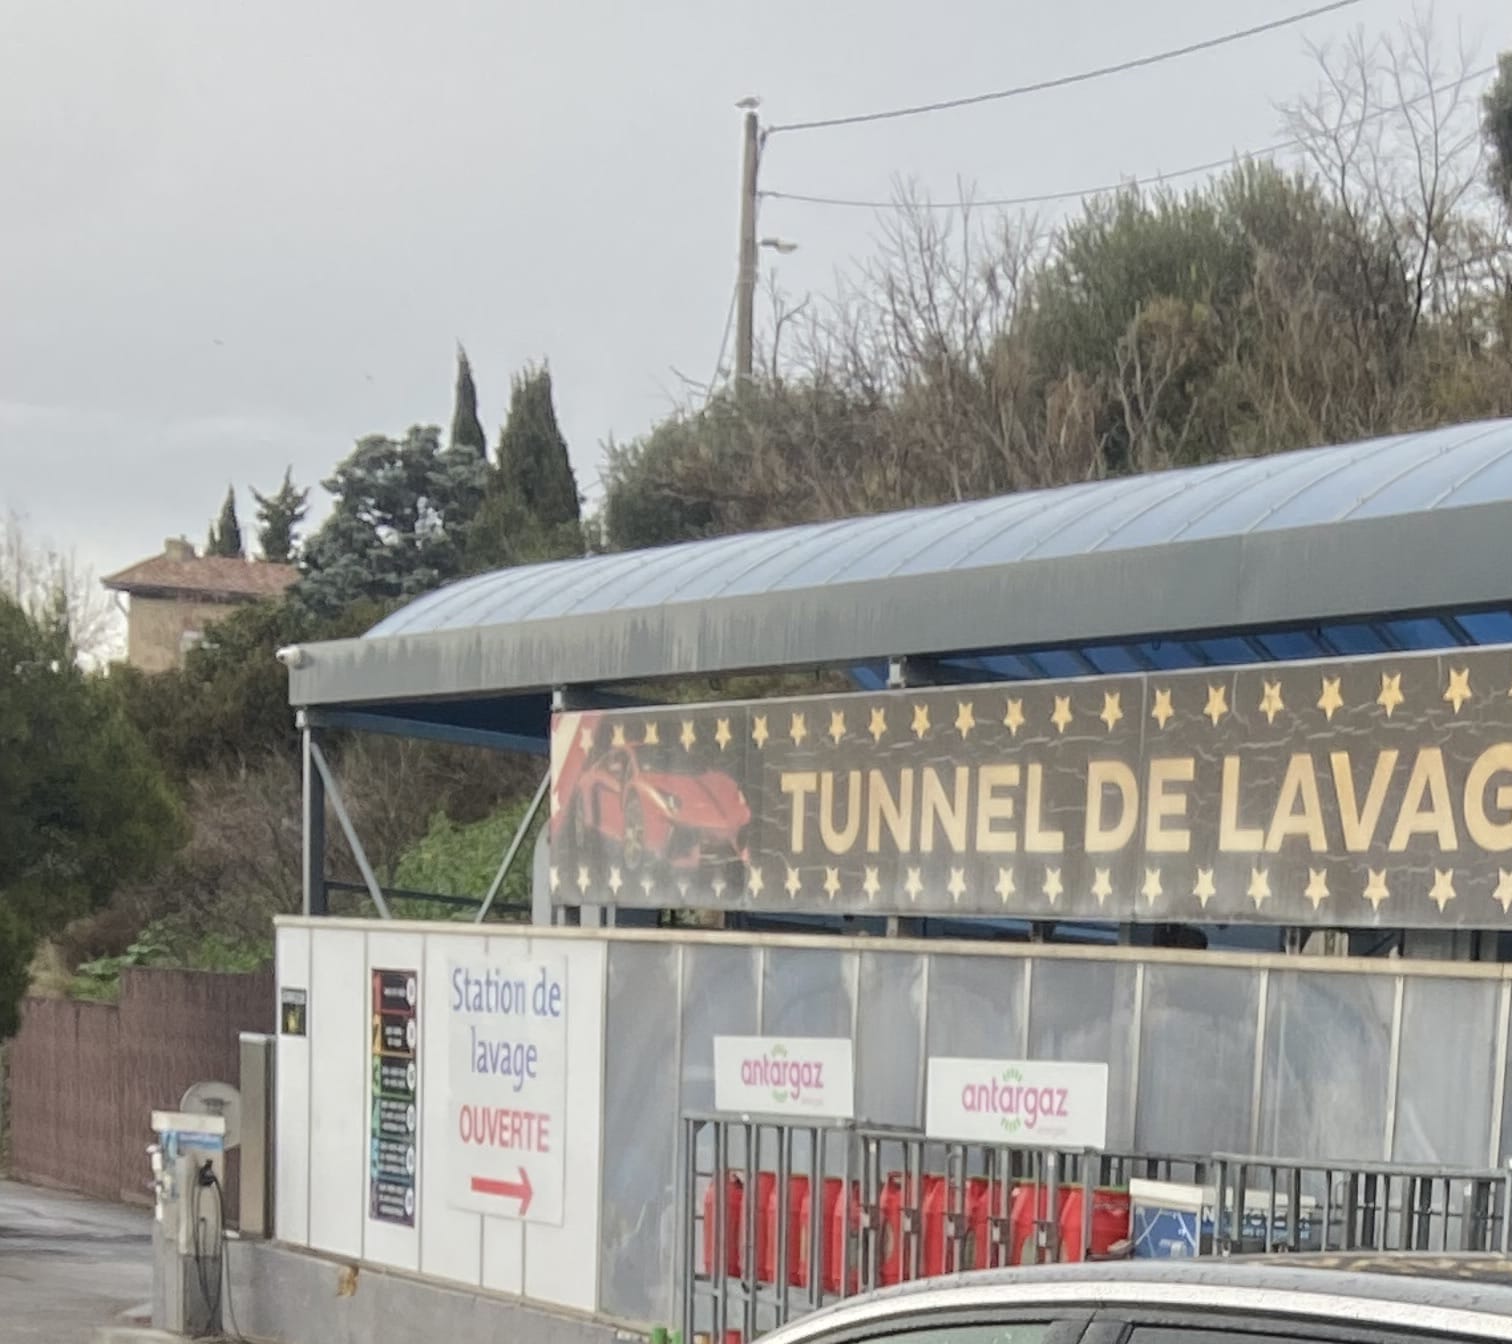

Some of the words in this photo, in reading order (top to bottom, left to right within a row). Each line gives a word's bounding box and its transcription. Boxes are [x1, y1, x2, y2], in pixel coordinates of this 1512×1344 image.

[781, 762, 1064, 854] TUNNEL
[1085, 757, 1195, 853] DE
[452, 967, 526, 1015] Station
[532, 966, 561, 1017] de
[470, 1025, 538, 1092] lavage
[740, 1052, 825, 1101] antargaz
[459, 1104, 550, 1153] OUVERTE
[961, 1076, 1068, 1129] antargaz
